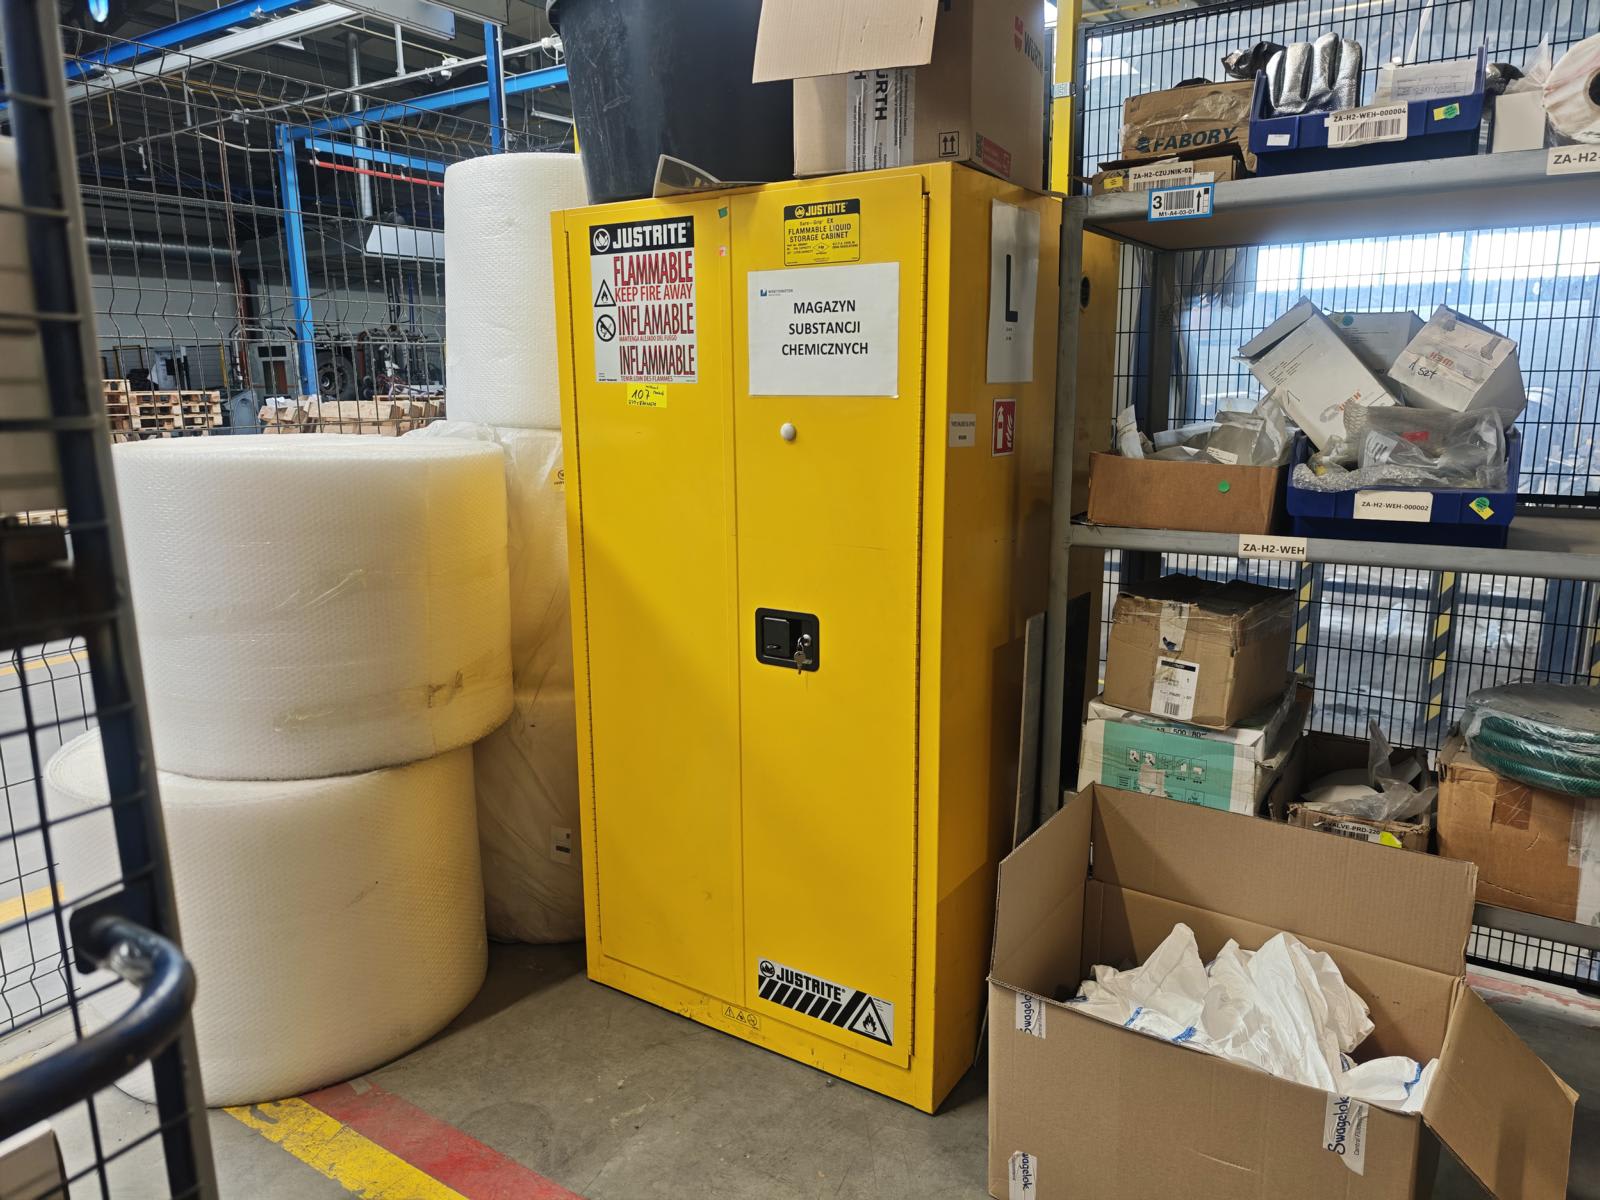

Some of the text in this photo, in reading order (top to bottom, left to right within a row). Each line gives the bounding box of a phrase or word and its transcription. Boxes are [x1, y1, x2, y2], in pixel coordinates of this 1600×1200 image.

[1333, 108, 1406, 122] ZA-H2-WEH-000004
[1153, 126, 1238, 152] FABORY
[1133, 167, 1192, 180] ZA-H2-CZUJNIK-02
[1152, 195, 1162, 209] 3
[805, 202, 847, 217] JUSTRITE
[612, 222, 687, 249] JUSTRITE
[788, 223, 851, 236] FLAMMABLE LIQUID
[789, 231, 848, 243] STORAGE CABINET
[613, 250, 693, 287] FLAMMABLE
[614, 283, 693, 302] KEEP FIRE AWAY
[793, 300, 856, 314] MAGAZYN
[618, 303, 694, 336] INFLAMABLE
[788, 321, 861, 335] SUBSTANCJI
[781, 342, 869, 356] CHEMICZNYCH
[619, 344, 695, 376] INFLAMMABLE
[1361, 501, 1429, 511] ZA-H2-WEH-000002
[1242, 543, 1305, 555] ZA-H2-WEH
[776, 967, 843, 1002] JUSTRITE
[1327, 1096, 1351, 1156] Swagelok
